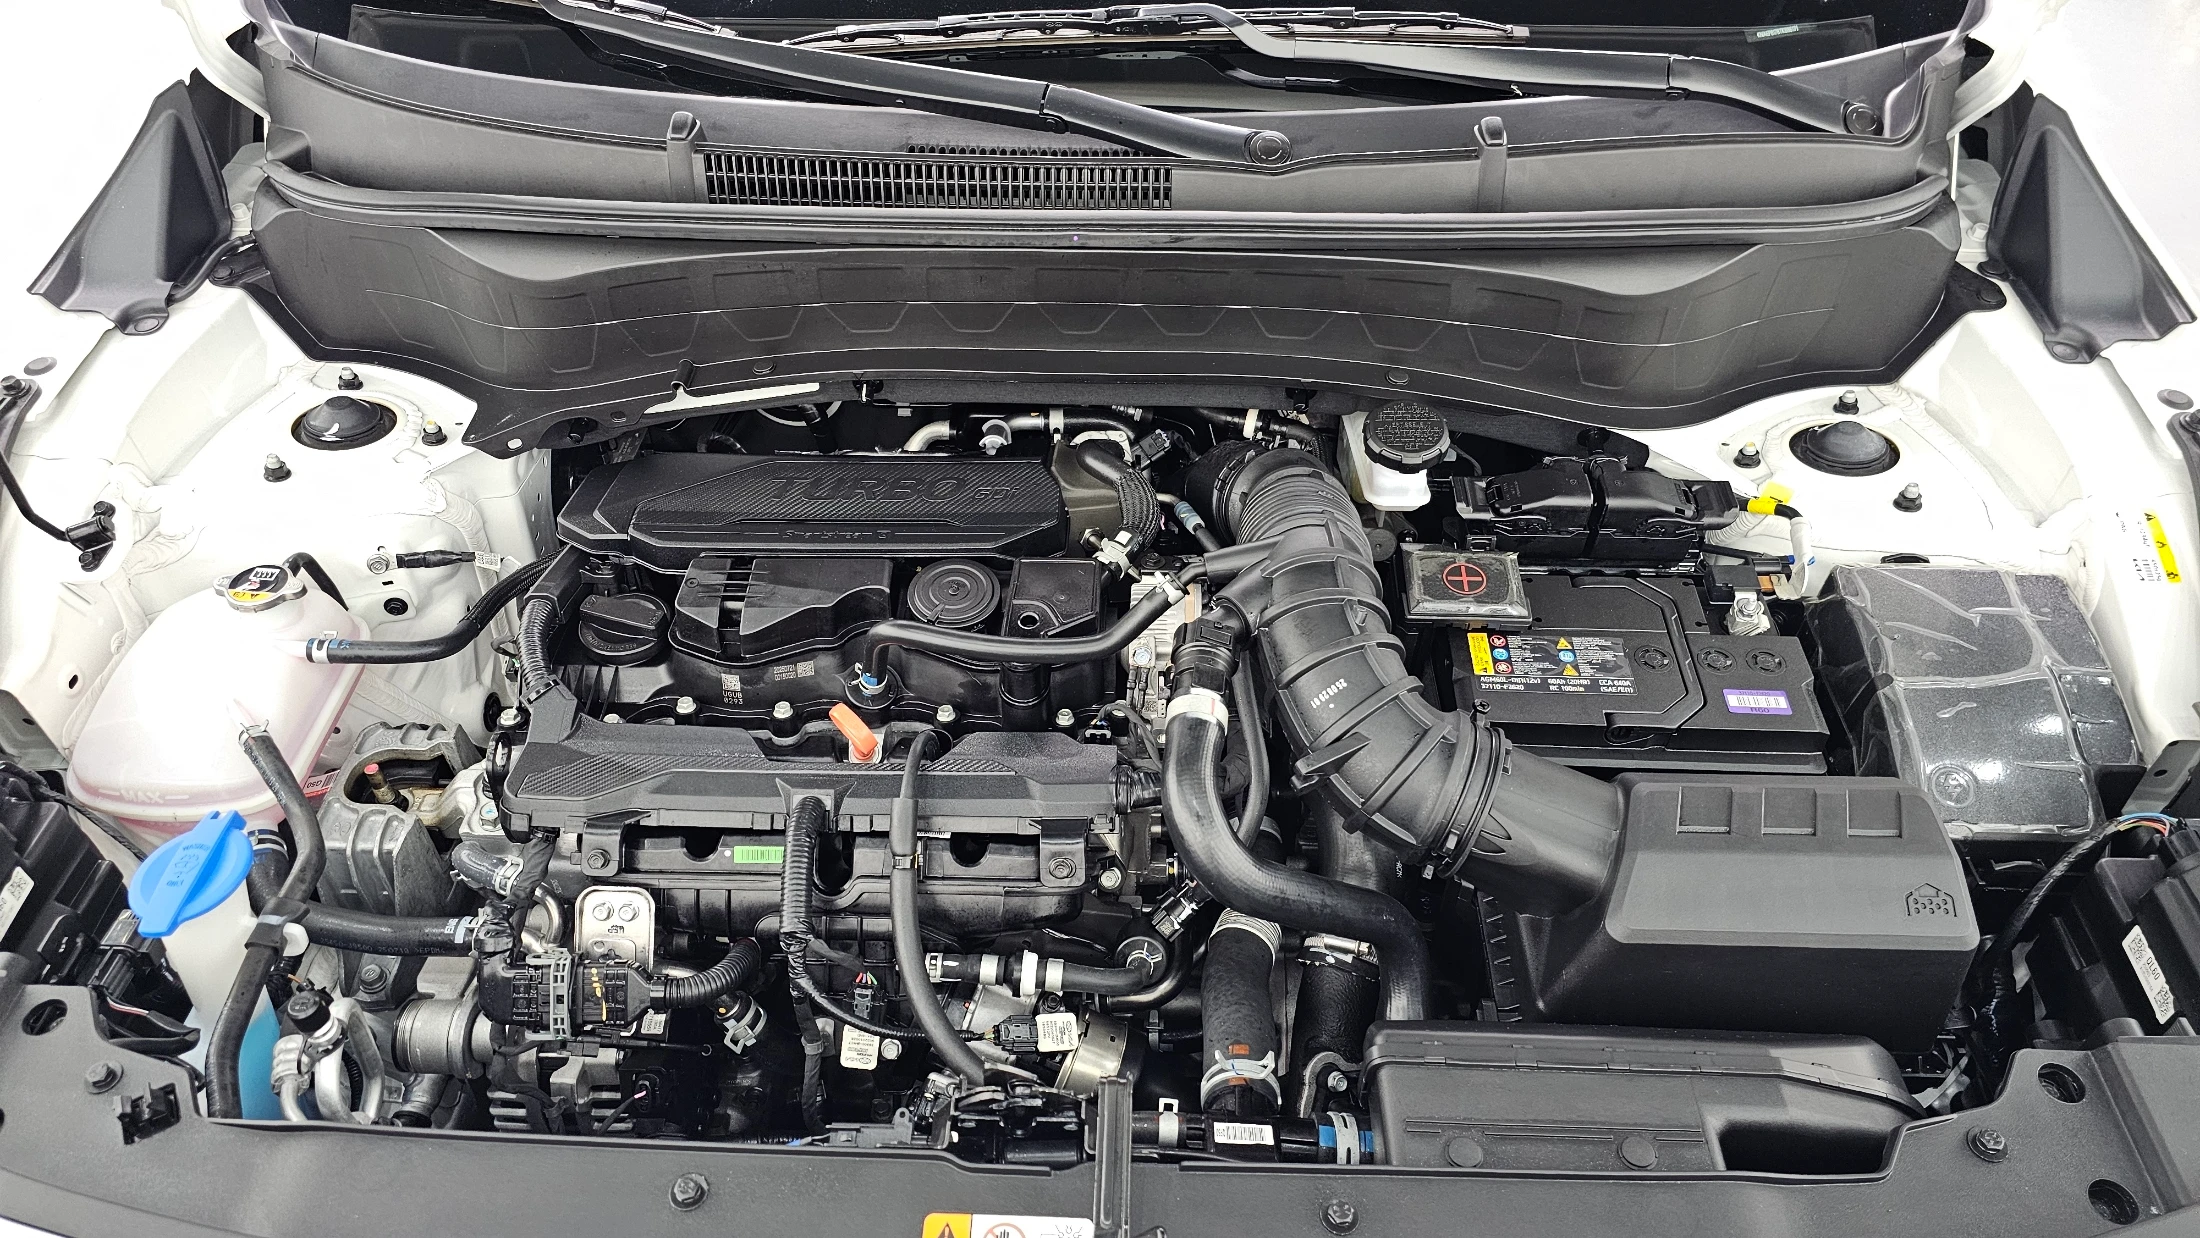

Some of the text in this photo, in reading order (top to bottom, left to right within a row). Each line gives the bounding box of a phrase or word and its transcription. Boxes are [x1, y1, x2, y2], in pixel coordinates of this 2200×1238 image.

[770, 476, 966, 502] TURBO
[722, 690, 743, 699] UGUB
[723, 697, 744, 705] 0293
[120, 789, 164, 805] MAX
